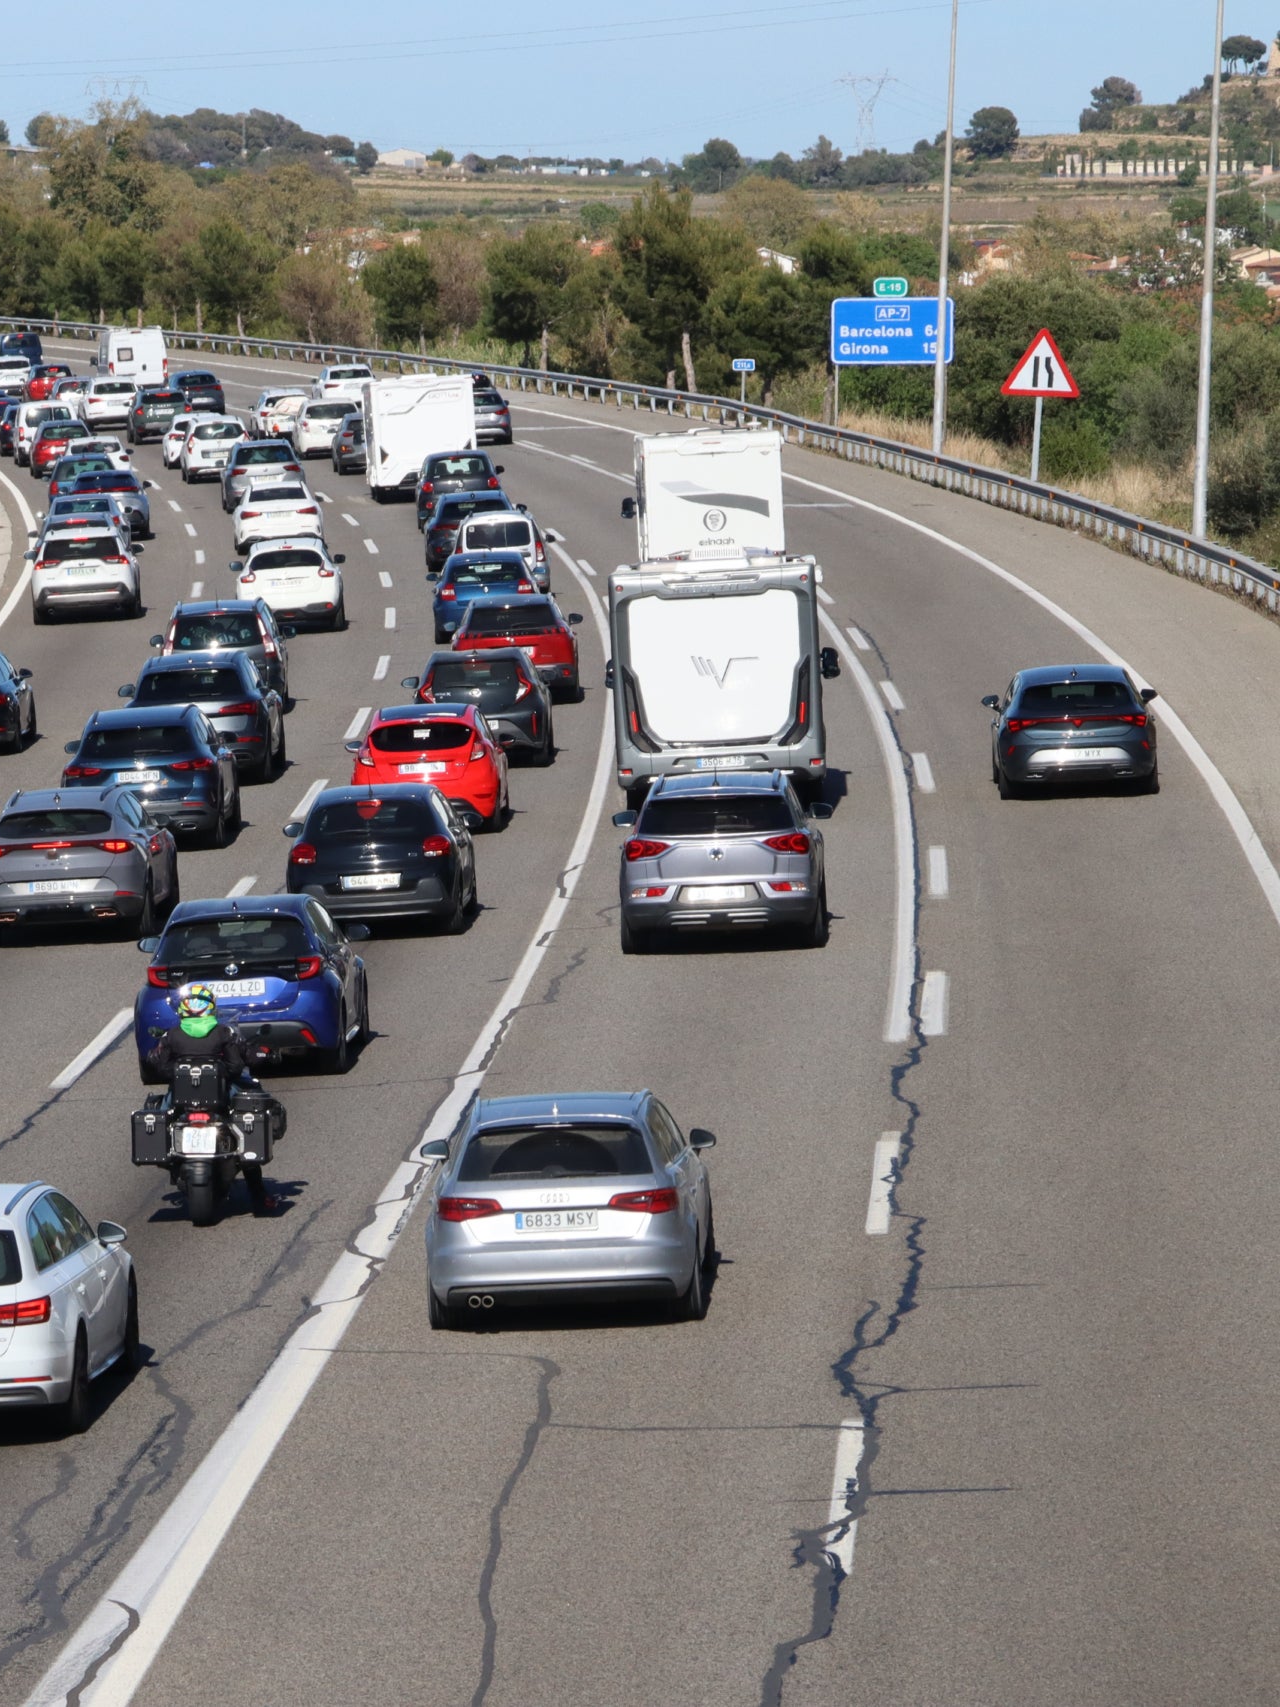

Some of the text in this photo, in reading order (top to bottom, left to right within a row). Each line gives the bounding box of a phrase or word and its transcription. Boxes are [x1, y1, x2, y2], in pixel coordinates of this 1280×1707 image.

[879, 283, 902, 291] E-15
[878, 308, 907, 318] AP-7
[840, 325, 913, 337] Barcelona
[840, 342, 889, 354] Girona
[525, 1211, 594, 1227] 6833 MSY
